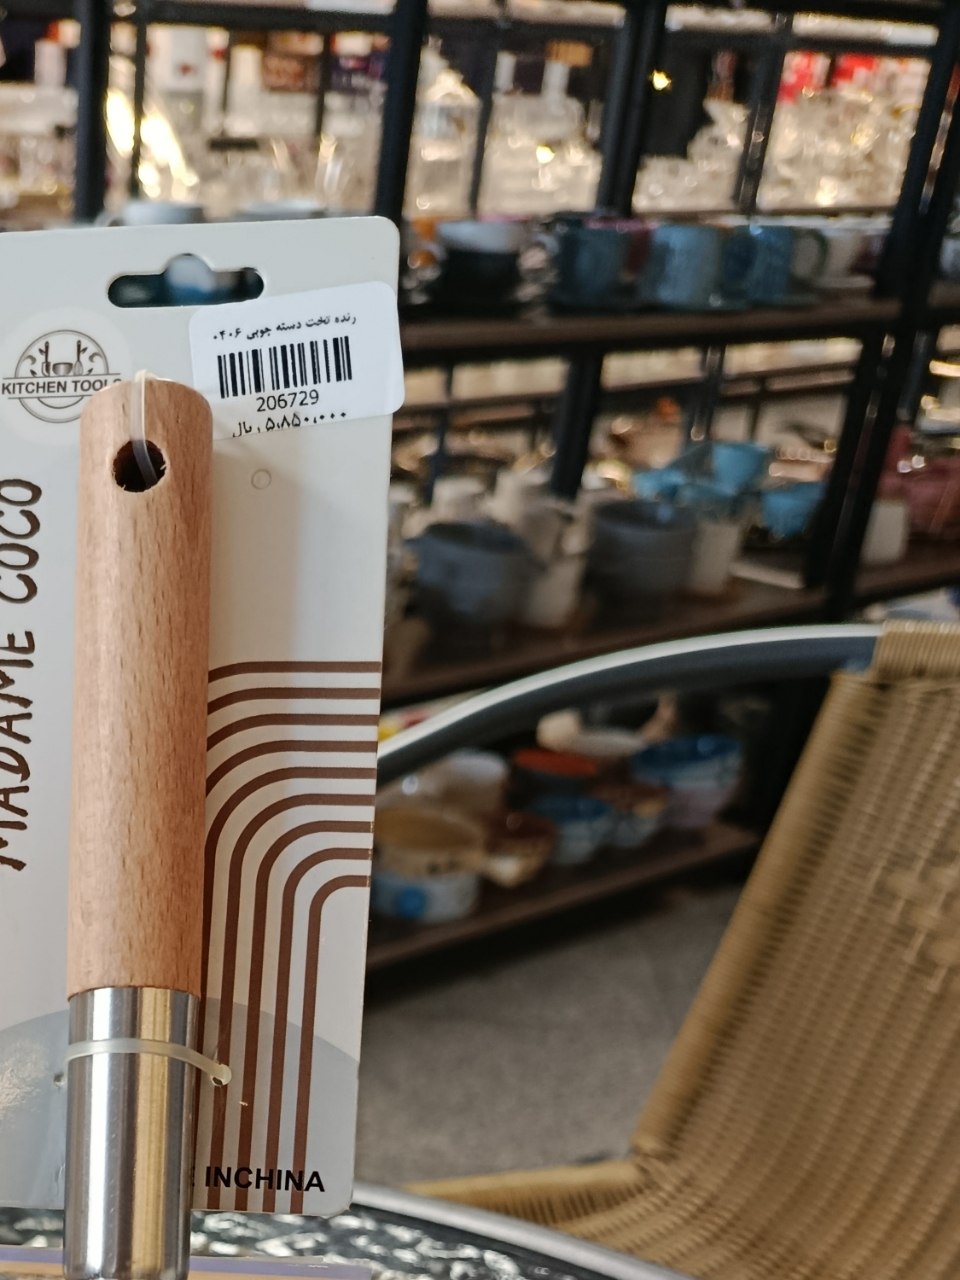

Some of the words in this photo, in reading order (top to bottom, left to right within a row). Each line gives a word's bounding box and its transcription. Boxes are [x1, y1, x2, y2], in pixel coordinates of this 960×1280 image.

[276, 321, 302, 331] دسته
[334, 312, 357, 325] رنده
[1, 380, 68, 395] KITCHEN
[72, 378, 122, 393] TOO
[256, 388, 320, 412] 206729
[204, 1165, 326, 1193] INCHINA
